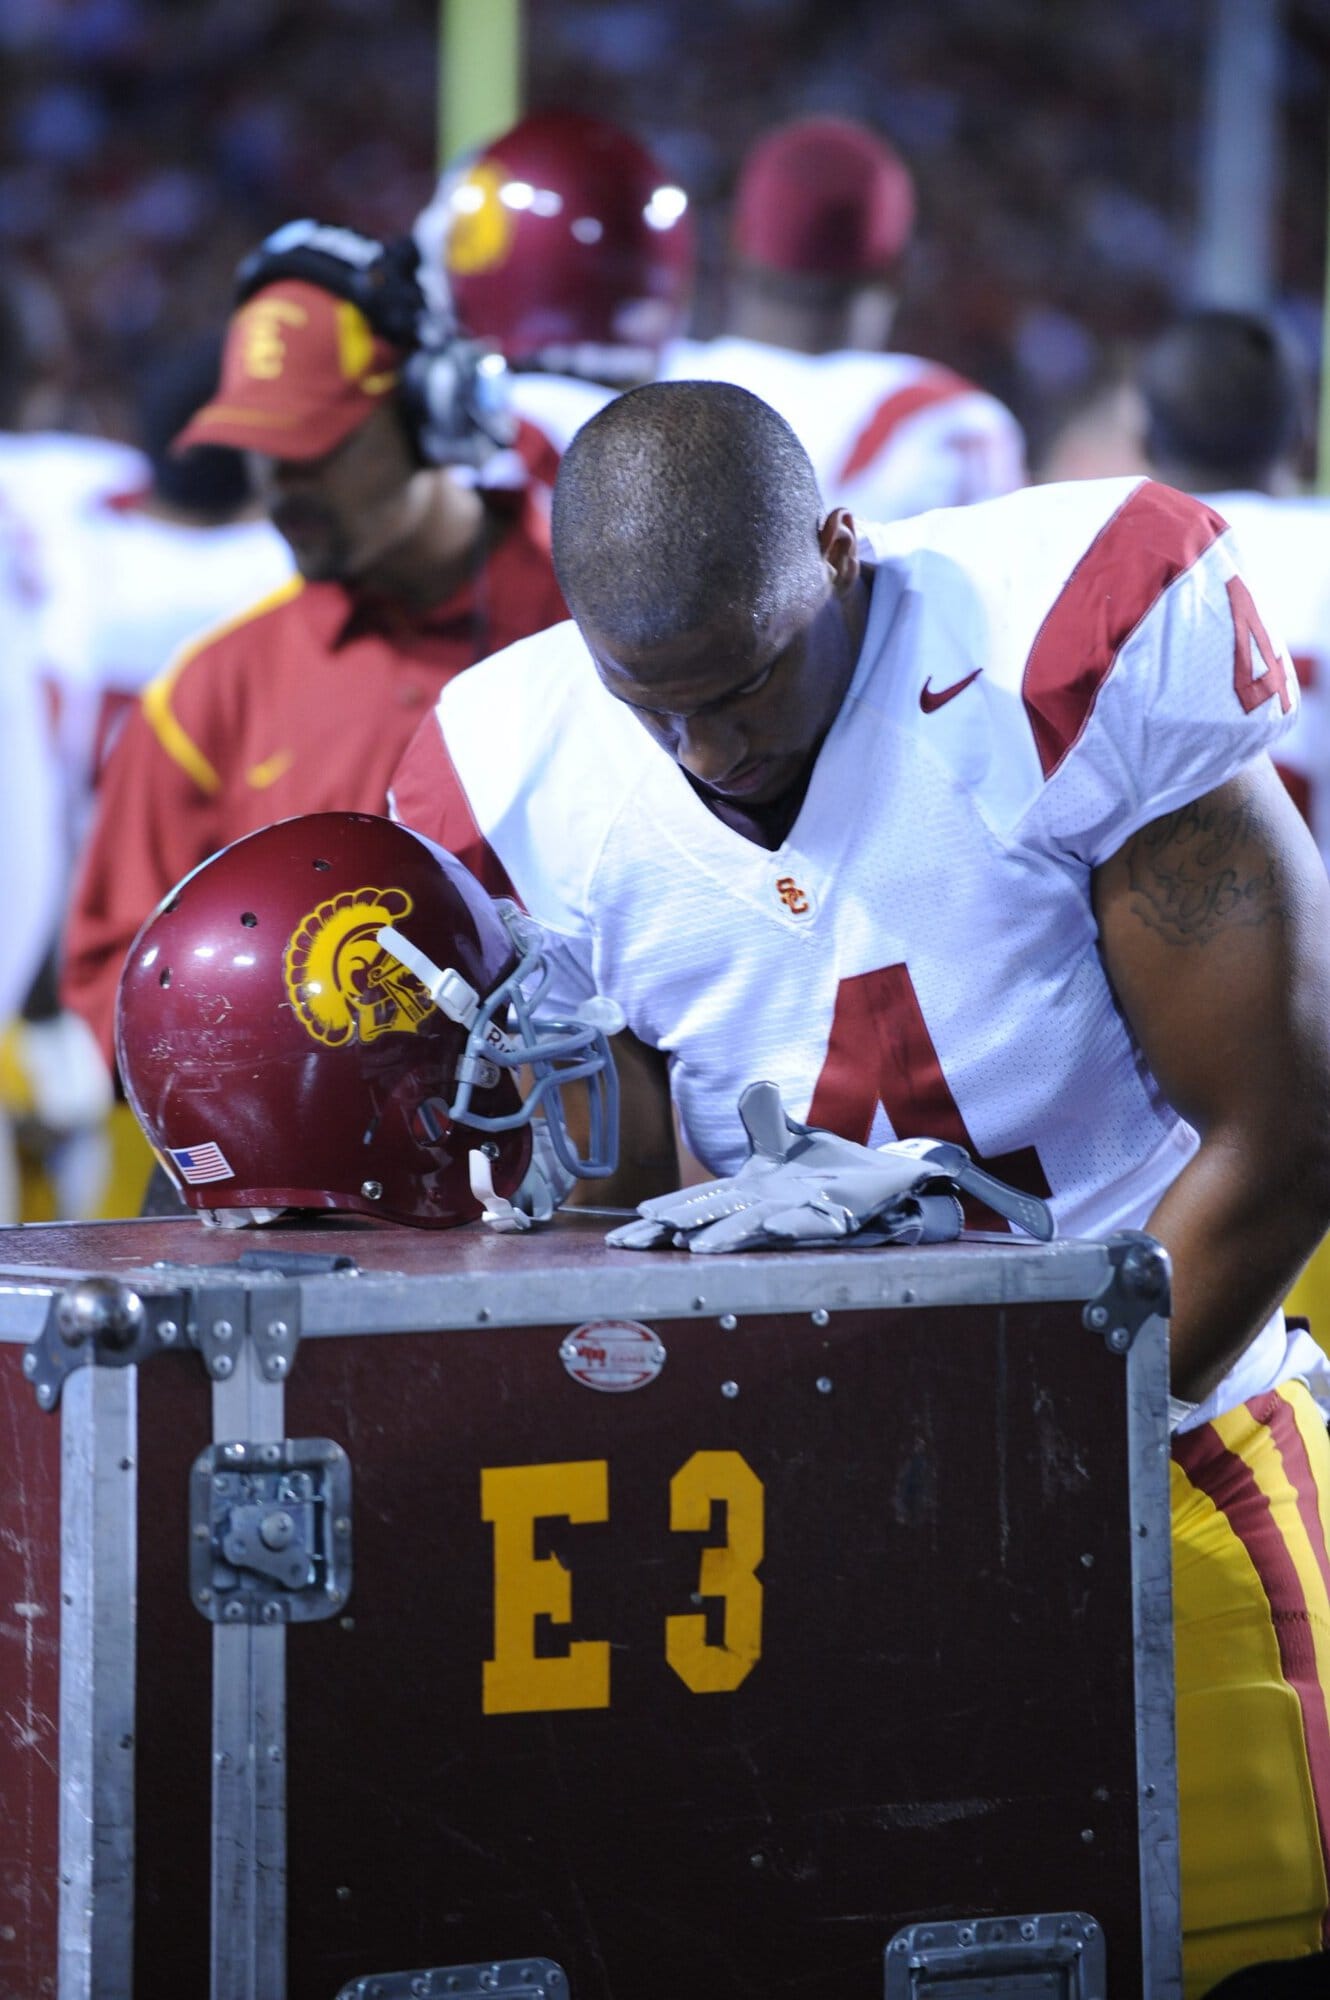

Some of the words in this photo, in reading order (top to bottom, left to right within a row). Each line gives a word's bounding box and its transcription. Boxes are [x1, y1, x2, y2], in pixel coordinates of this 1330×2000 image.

[1225, 574, 1291, 715] 4
[775, 877, 809, 914] SC
[480, 1459, 609, 1715] E
[665, 1450, 764, 1694] 3
